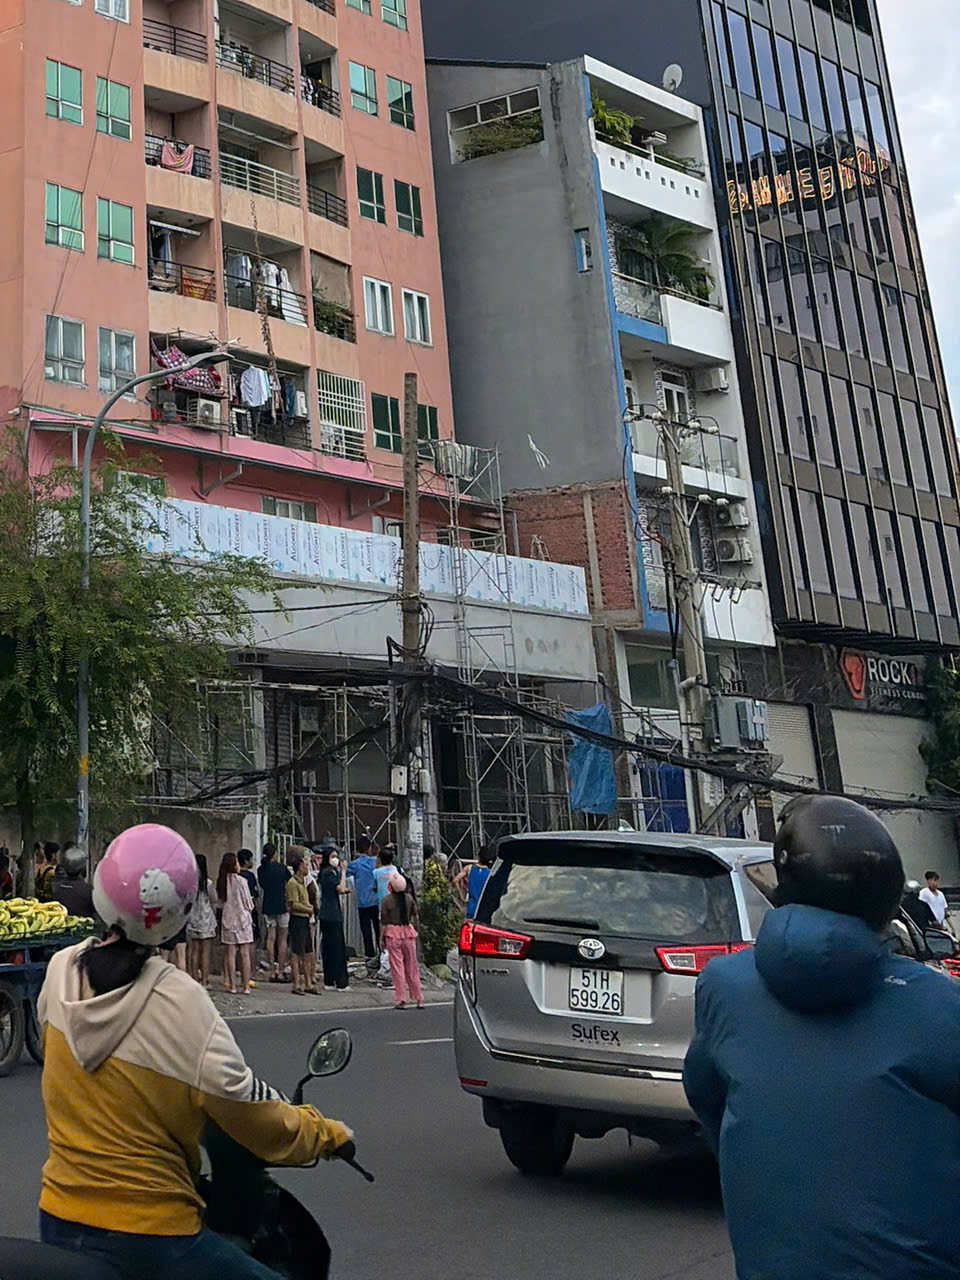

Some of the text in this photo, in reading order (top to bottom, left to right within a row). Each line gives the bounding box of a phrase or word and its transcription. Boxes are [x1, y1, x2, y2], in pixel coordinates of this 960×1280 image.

[581, 969, 610, 990] 51H
[570, 990, 620, 1010] 599.26
[571, 1023, 620, 1042] Sufex
